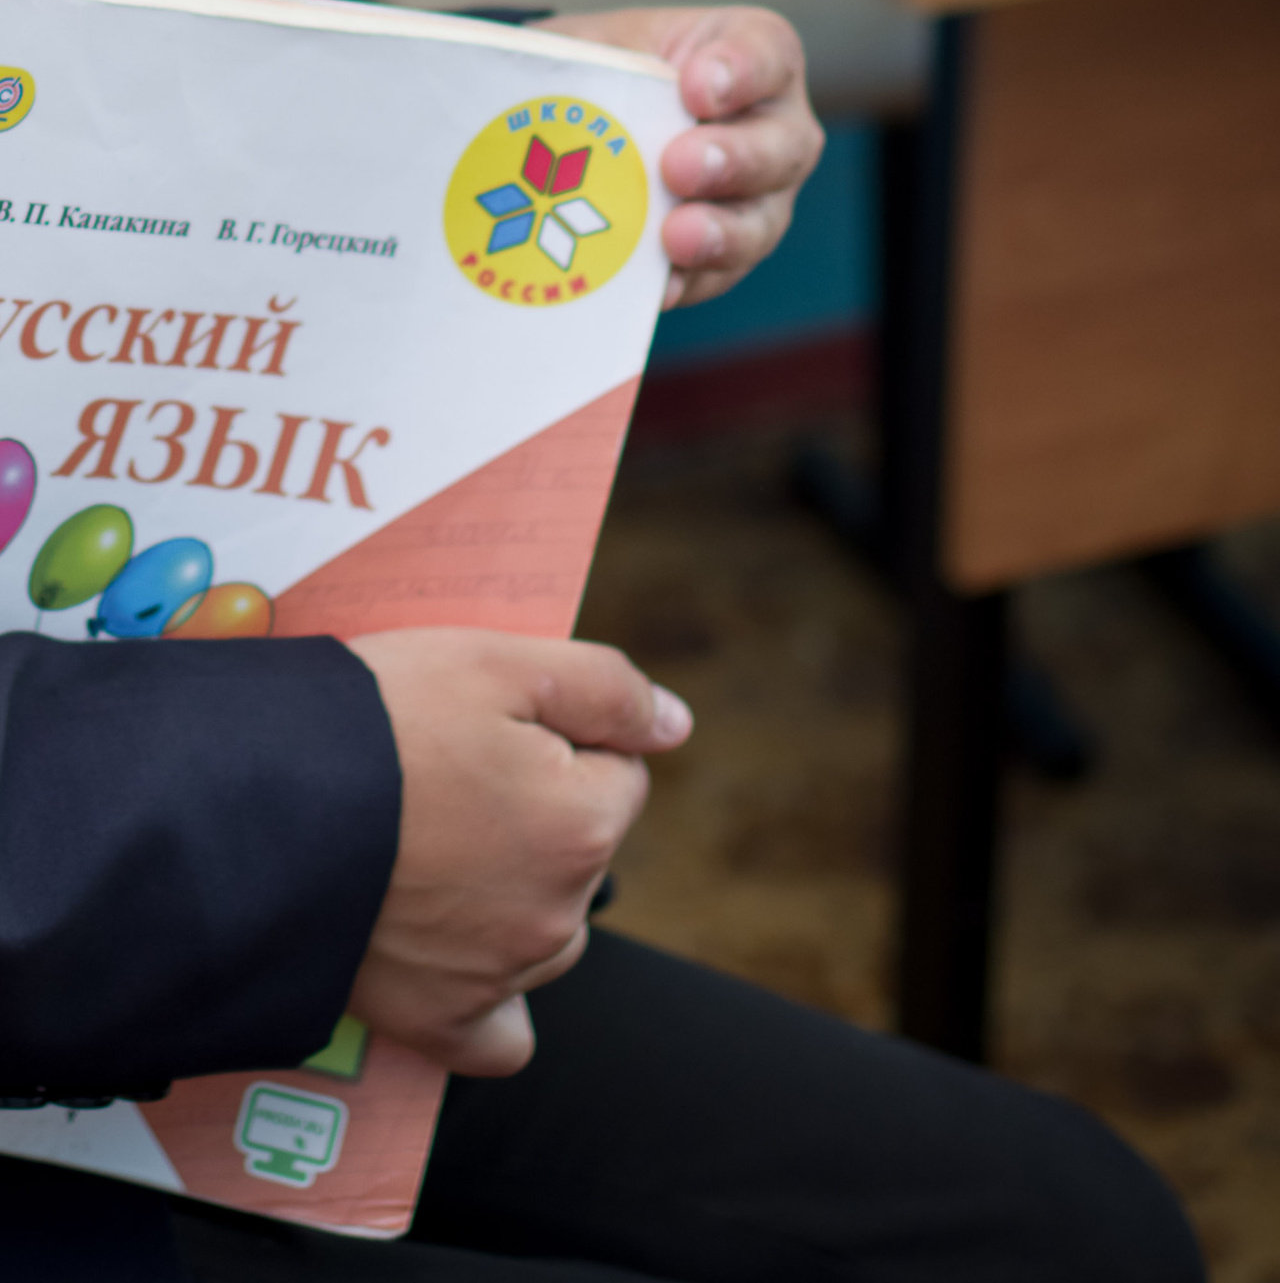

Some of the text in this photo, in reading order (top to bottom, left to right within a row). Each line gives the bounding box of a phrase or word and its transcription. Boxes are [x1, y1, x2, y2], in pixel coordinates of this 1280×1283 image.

[507, 101, 626, 157] ШКОЛА
[23, 202, 50, 227] П.
[57, 205, 191, 238] Канакина
[216, 218, 239, 242] В.
[245, 221, 265, 244] Г.
[269, 223, 399, 258] Горецкий
[460, 251, 588, 304] РОССИИ
